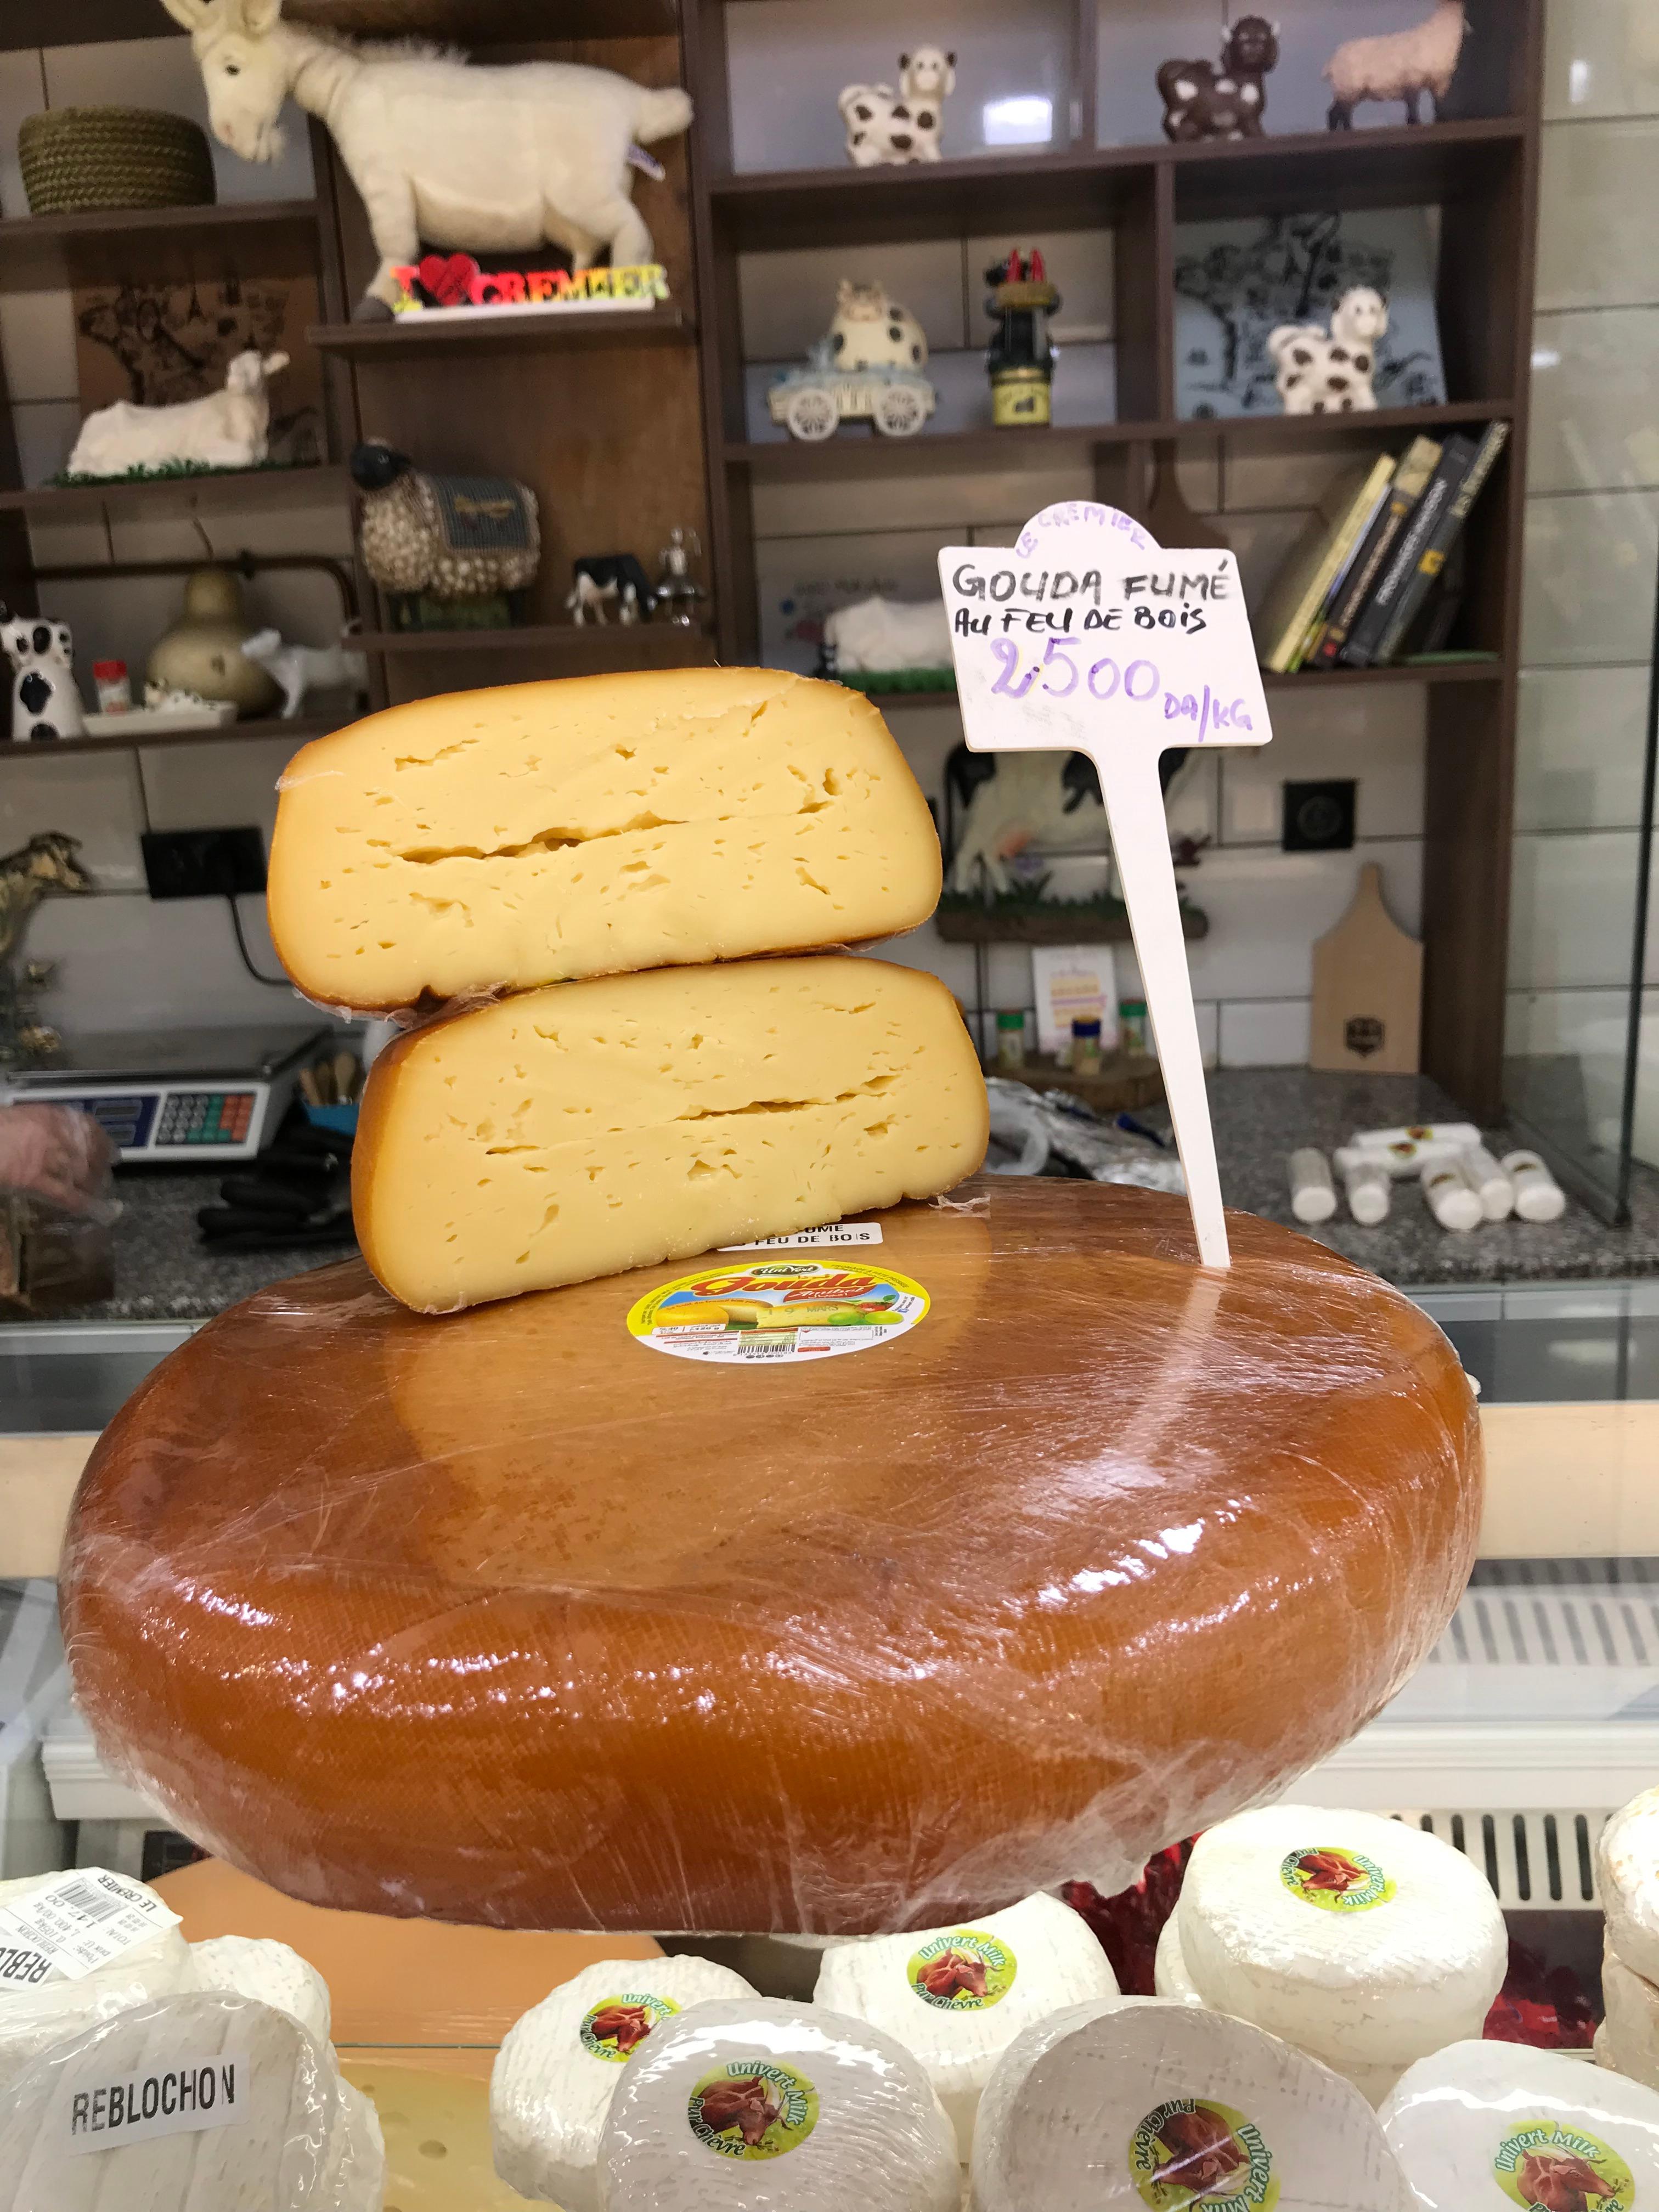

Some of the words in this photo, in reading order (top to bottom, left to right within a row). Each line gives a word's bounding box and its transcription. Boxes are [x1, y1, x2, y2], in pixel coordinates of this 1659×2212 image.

[952, 564, 1102, 605] GOUDA
[1124, 558, 1231, 601] FUMÉ
[955, 608, 992, 636] AU
[1000, 608, 1073, 633] FEU
[1084, 608, 1124, 630] DE
[755, 1237, 789, 1245] FEU
[798, 1235, 820, 1243] DE
[830, 1232, 871, 1242] BOIS
[805, 1224, 844, 1233] UME
[690, 1273, 877, 1296] Gouda
[806, 1305, 839, 1313] MARS
[1352, 1854, 1385, 1893] Univert
[139, 1899, 157, 1912] LE
[1342, 1889, 1379, 1906] Milk
[918, 1936, 979, 1960] Univert
[978, 1942, 1007, 1967] Milk
[622, 1993, 673, 2016] Univert
[71, 2063, 235, 2136] REBLOCHON
[726, 2060, 797, 2090] Univert
[786, 2088, 808, 2125] Milk
[687, 2096, 705, 2124] Pur
[1163, 2097, 1197, 2119] Pur
[692, 2123, 747, 2156] Chèvre
[1494, 2128, 1549, 2173] Univert
[1551, 2130, 1601, 2159] Milk
[1237, 2123, 1273, 2204] Univert
